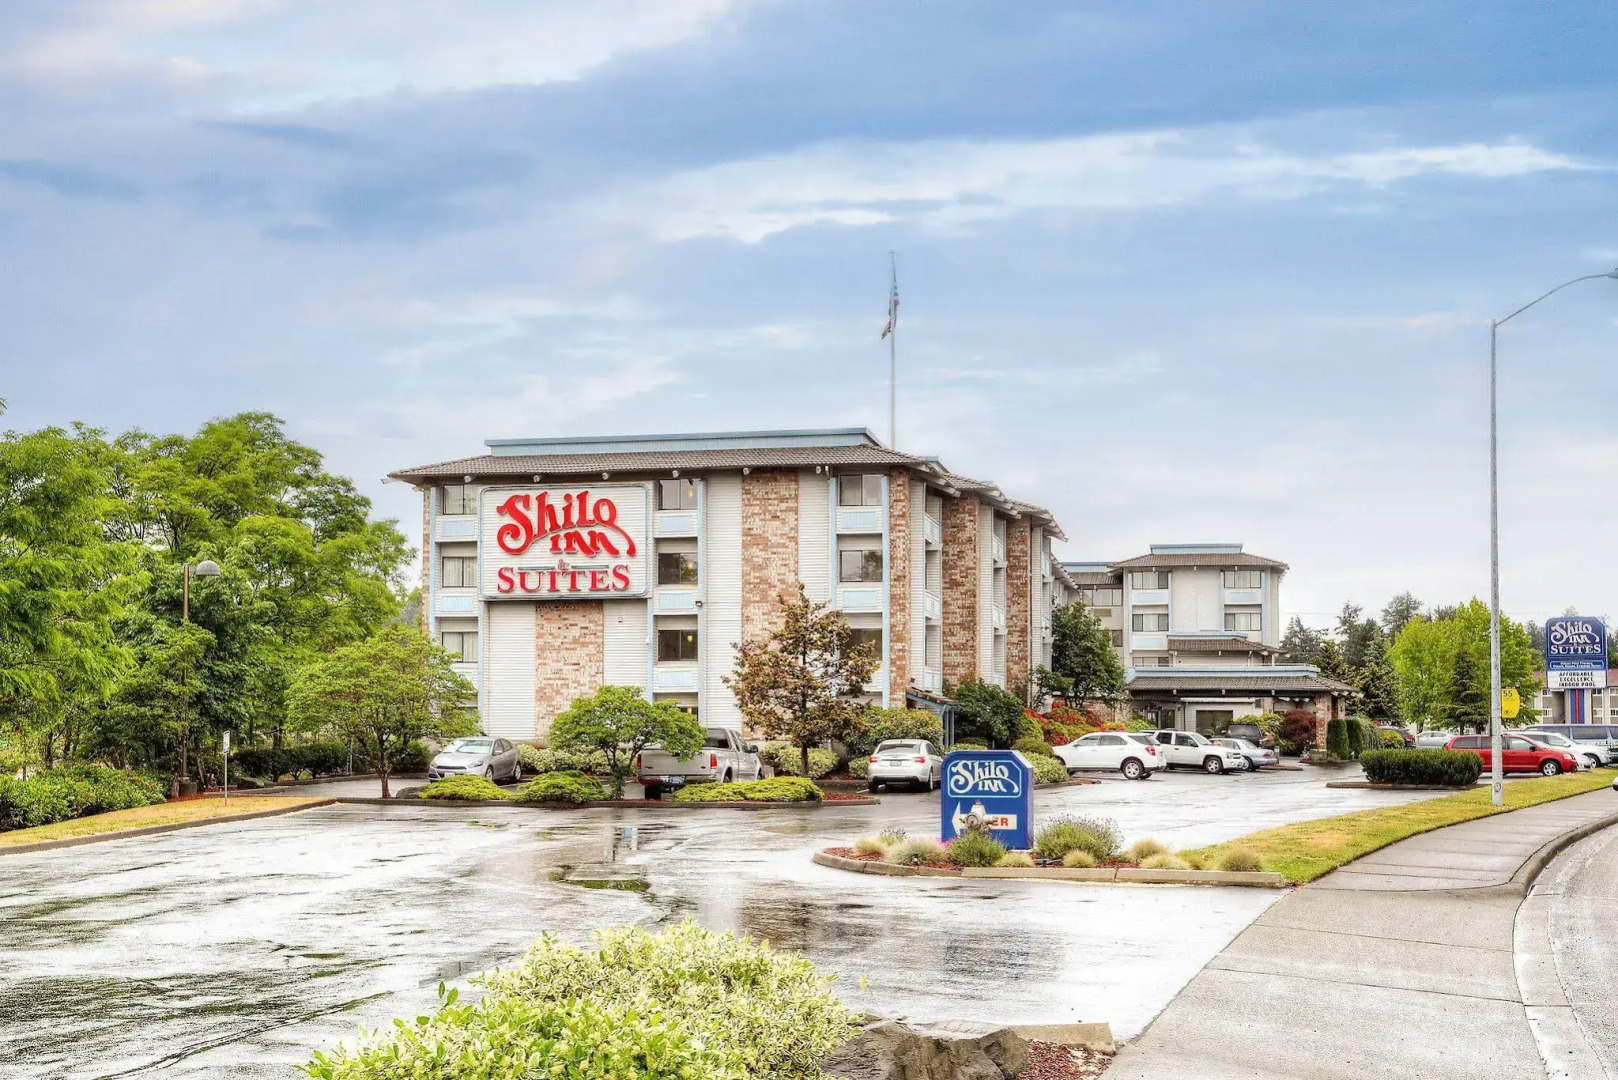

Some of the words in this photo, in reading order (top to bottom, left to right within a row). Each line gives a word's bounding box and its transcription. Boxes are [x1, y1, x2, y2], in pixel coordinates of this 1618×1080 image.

[496, 490, 636, 556] Shilo
[497, 564, 630, 593] SUITES
[1550, 621, 1599, 644] Shilo
[1550, 644, 1601, 654] SUITES
[950, 760, 1019, 793] Shilo
